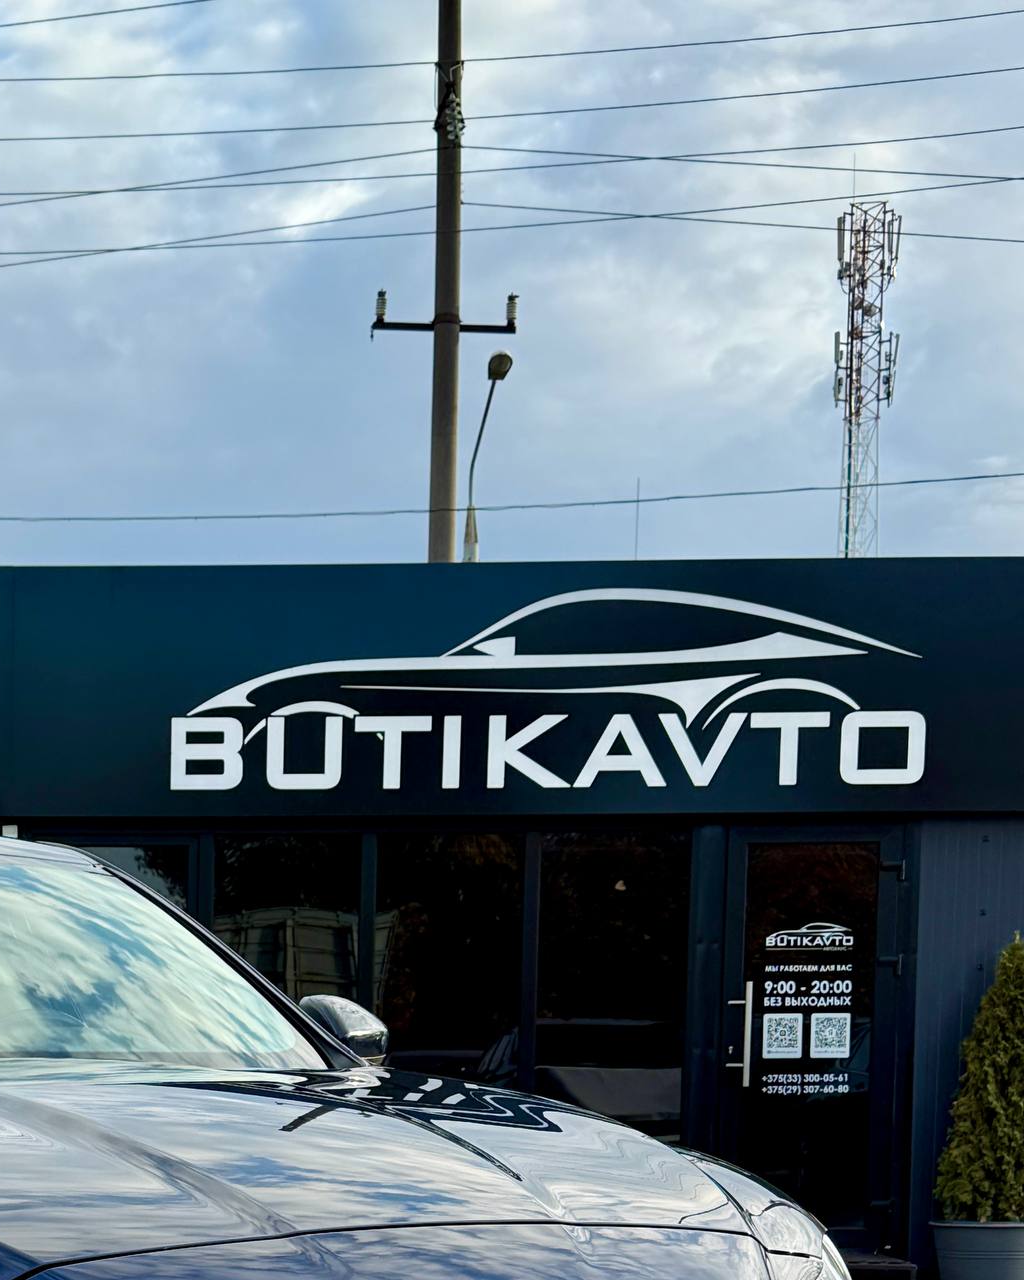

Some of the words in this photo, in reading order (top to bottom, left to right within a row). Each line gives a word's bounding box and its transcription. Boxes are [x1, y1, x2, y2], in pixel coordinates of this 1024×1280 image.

[170, 710, 926, 791] BUTIKAVTO
[765, 935, 854, 947] BUTIKAVTO
[779, 964, 818, 972] РАБОТАЕМ
[820, 964, 835, 972] ДЛЯ
[764, 980, 796, 994] 9:00
[810, 980, 852, 994] 20:00
[763, 997, 782, 1007] БЕЗ
[784, 996, 852, 1007] ВЫХОДНЫХ
[761, 1074, 802, 1084] +375(33)
[803, 1073, 848, 1083] 300-05-61
[761, 1085, 802, 1095] +375(29)
[803, 1084, 849, 1094] 307-60-80
